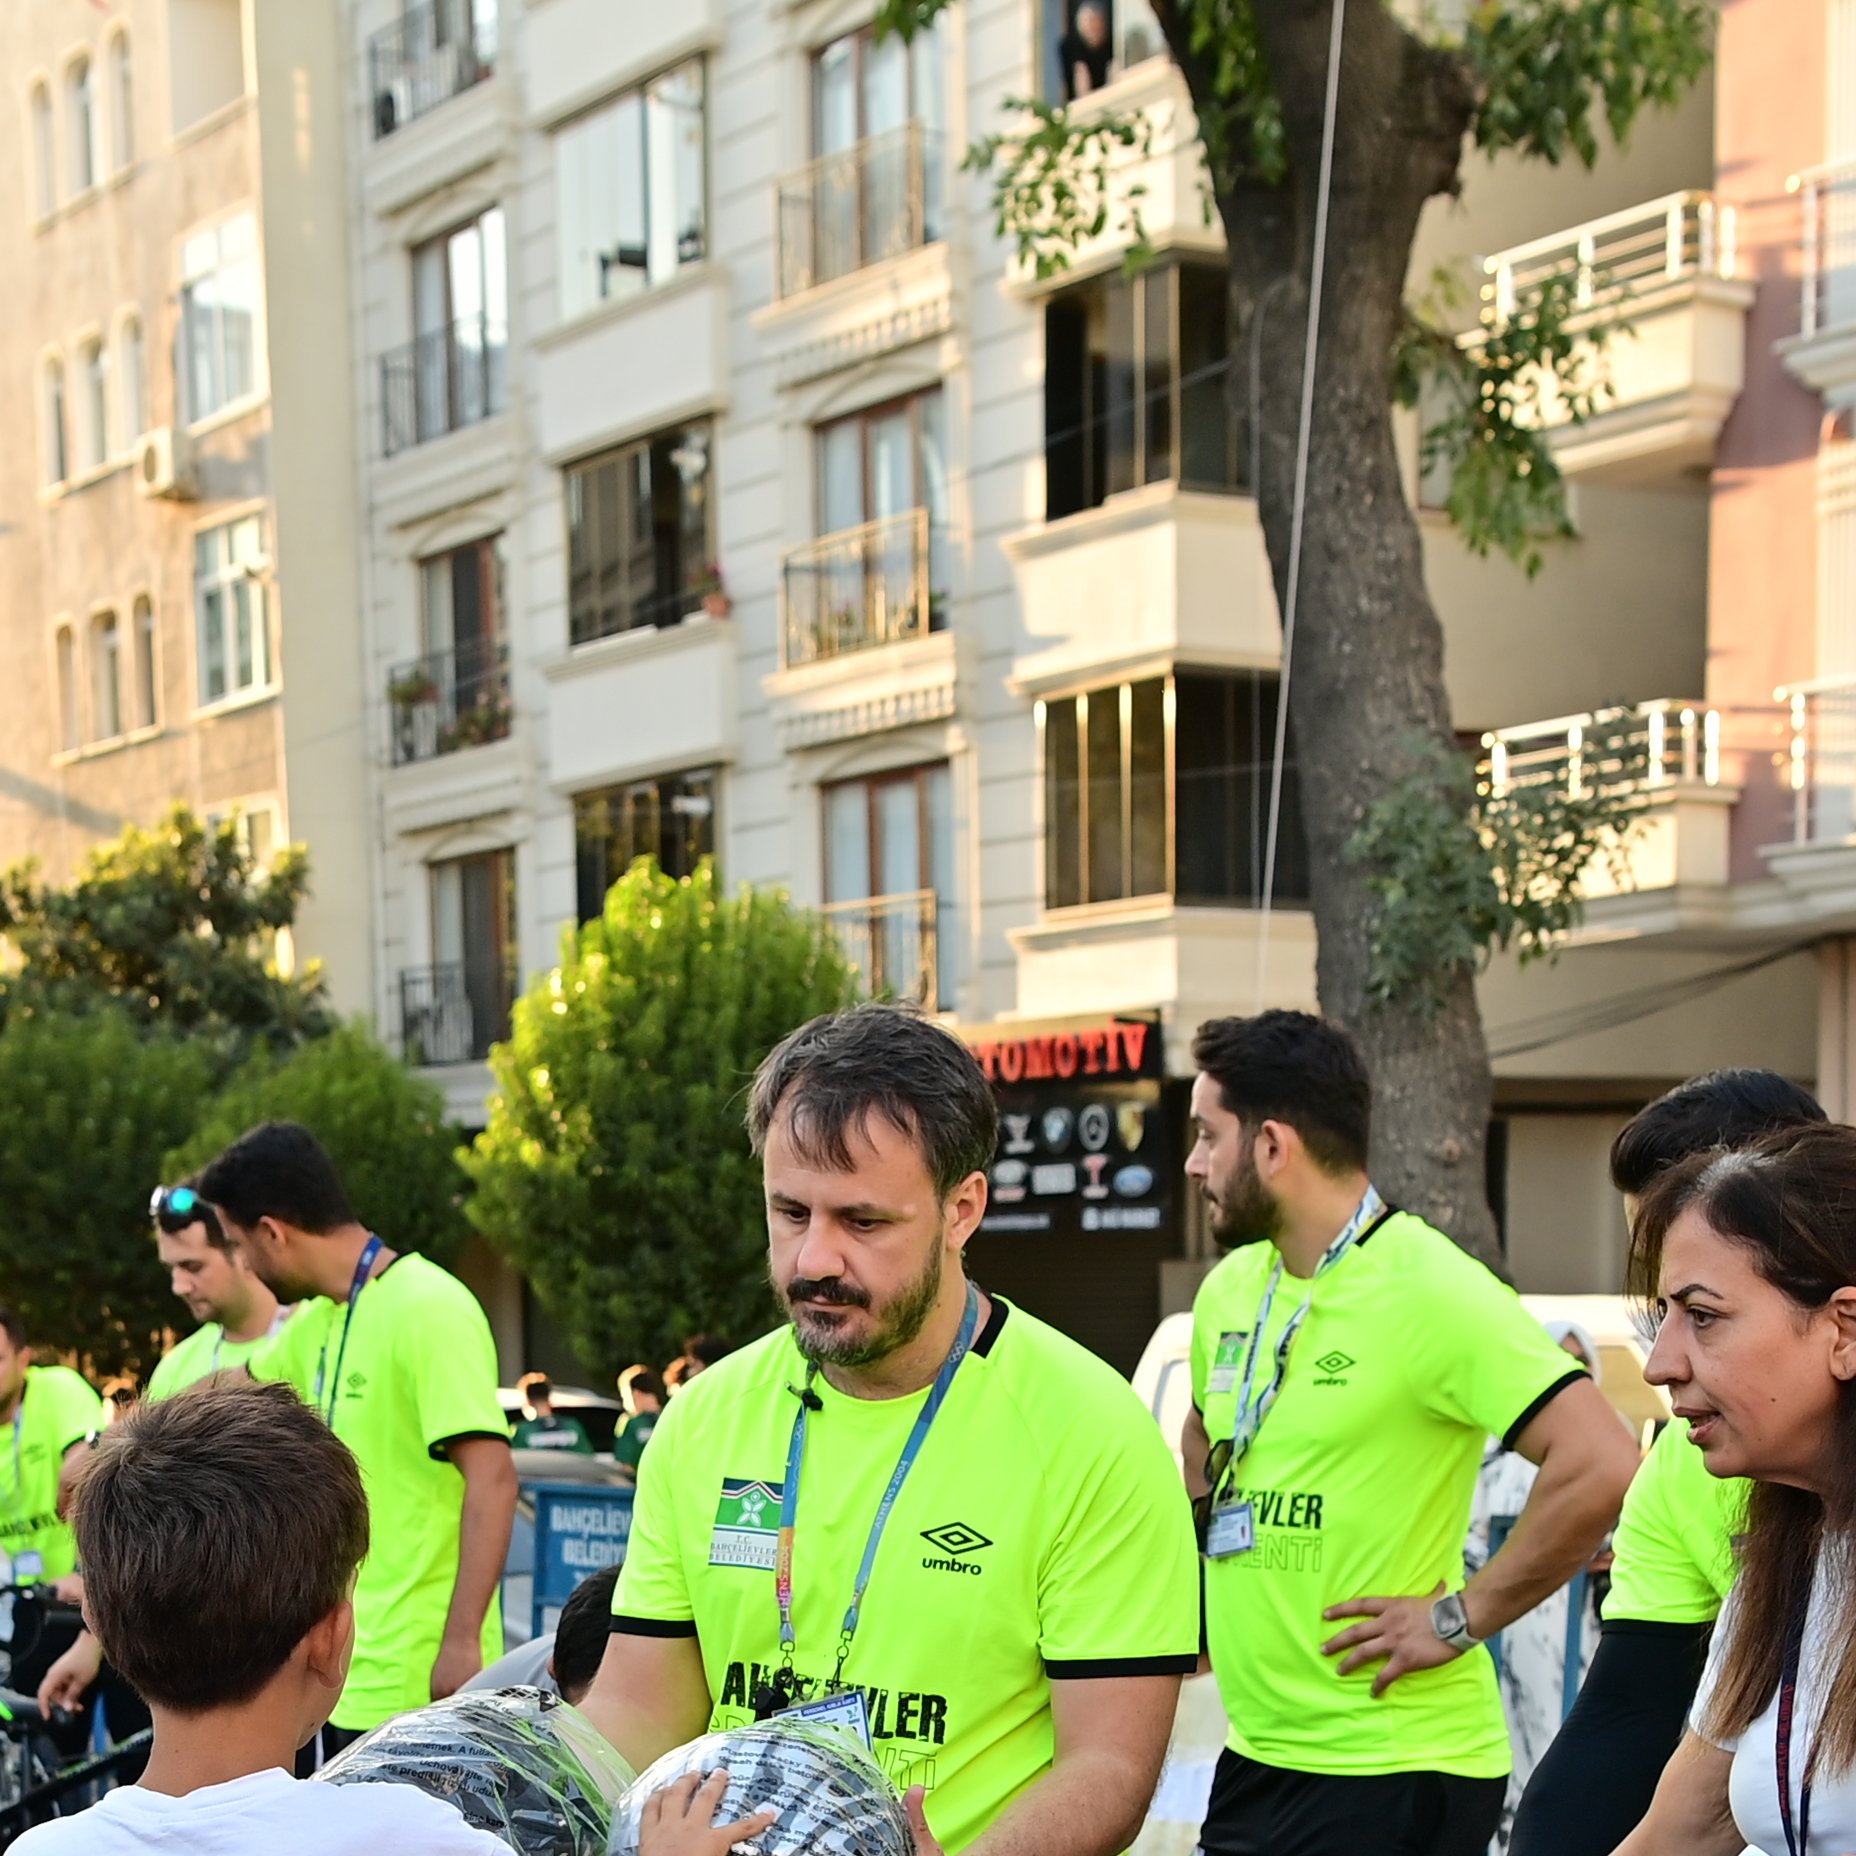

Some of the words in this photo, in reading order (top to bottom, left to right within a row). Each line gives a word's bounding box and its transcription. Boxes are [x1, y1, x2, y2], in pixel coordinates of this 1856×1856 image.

[974, 1015, 1148, 1083] TOMOTİV
[891, 1460, 909, 1485] 2004
[922, 1556, 982, 1576] umbro
